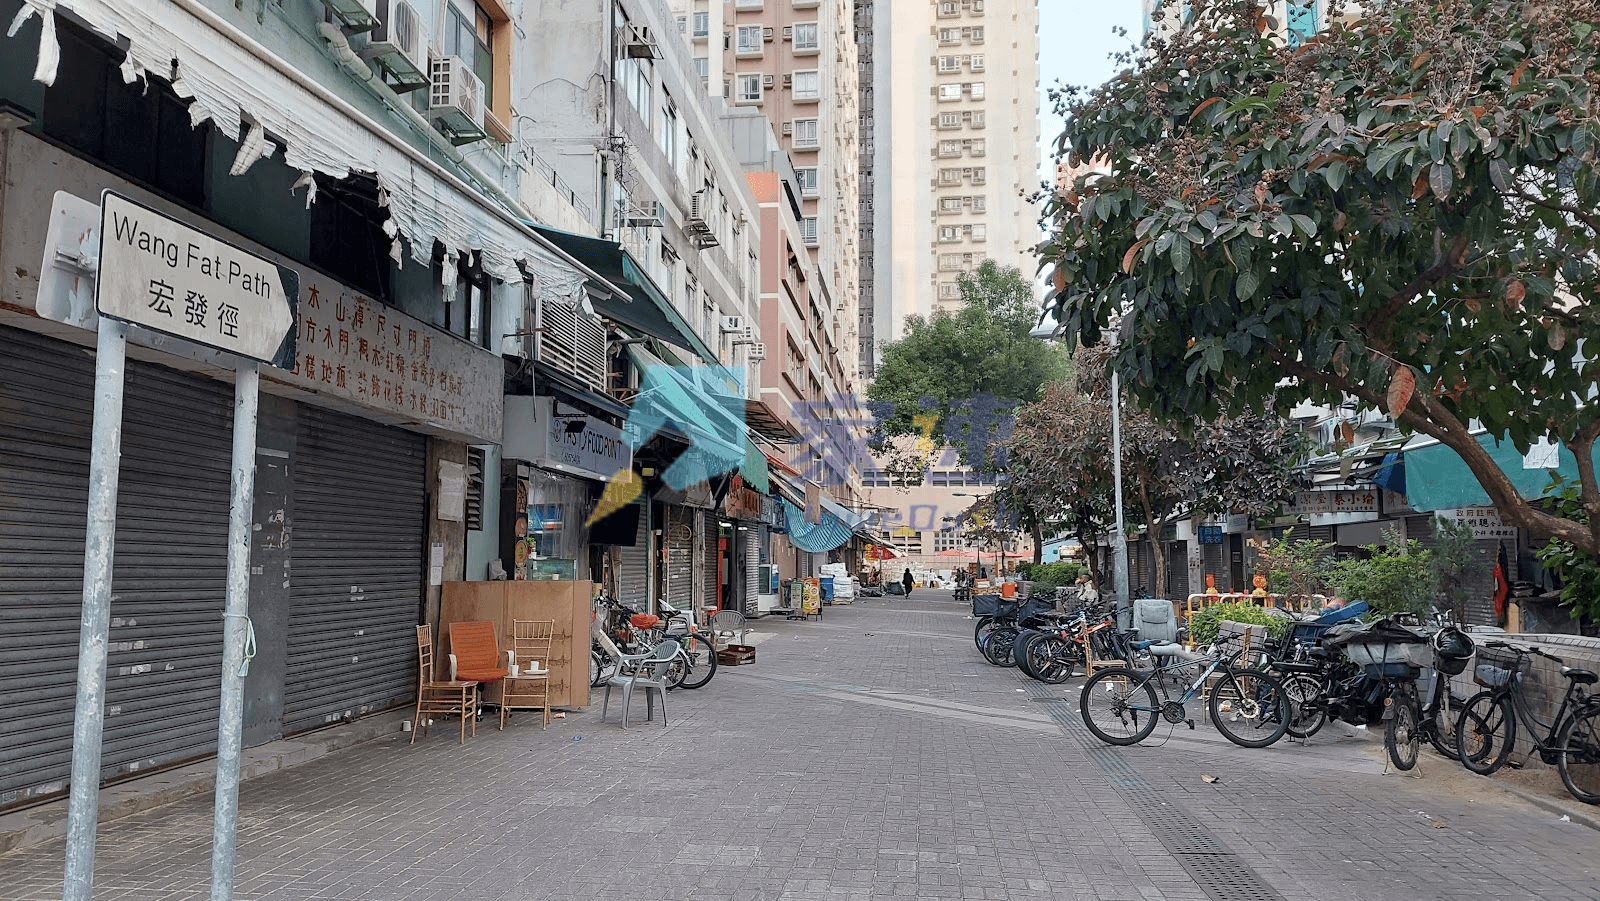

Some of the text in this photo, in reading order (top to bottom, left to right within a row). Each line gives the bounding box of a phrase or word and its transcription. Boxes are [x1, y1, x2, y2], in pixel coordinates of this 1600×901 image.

[113, 211, 271, 300] Wang Fat Path
[147, 279, 240, 339] 宏發徑
